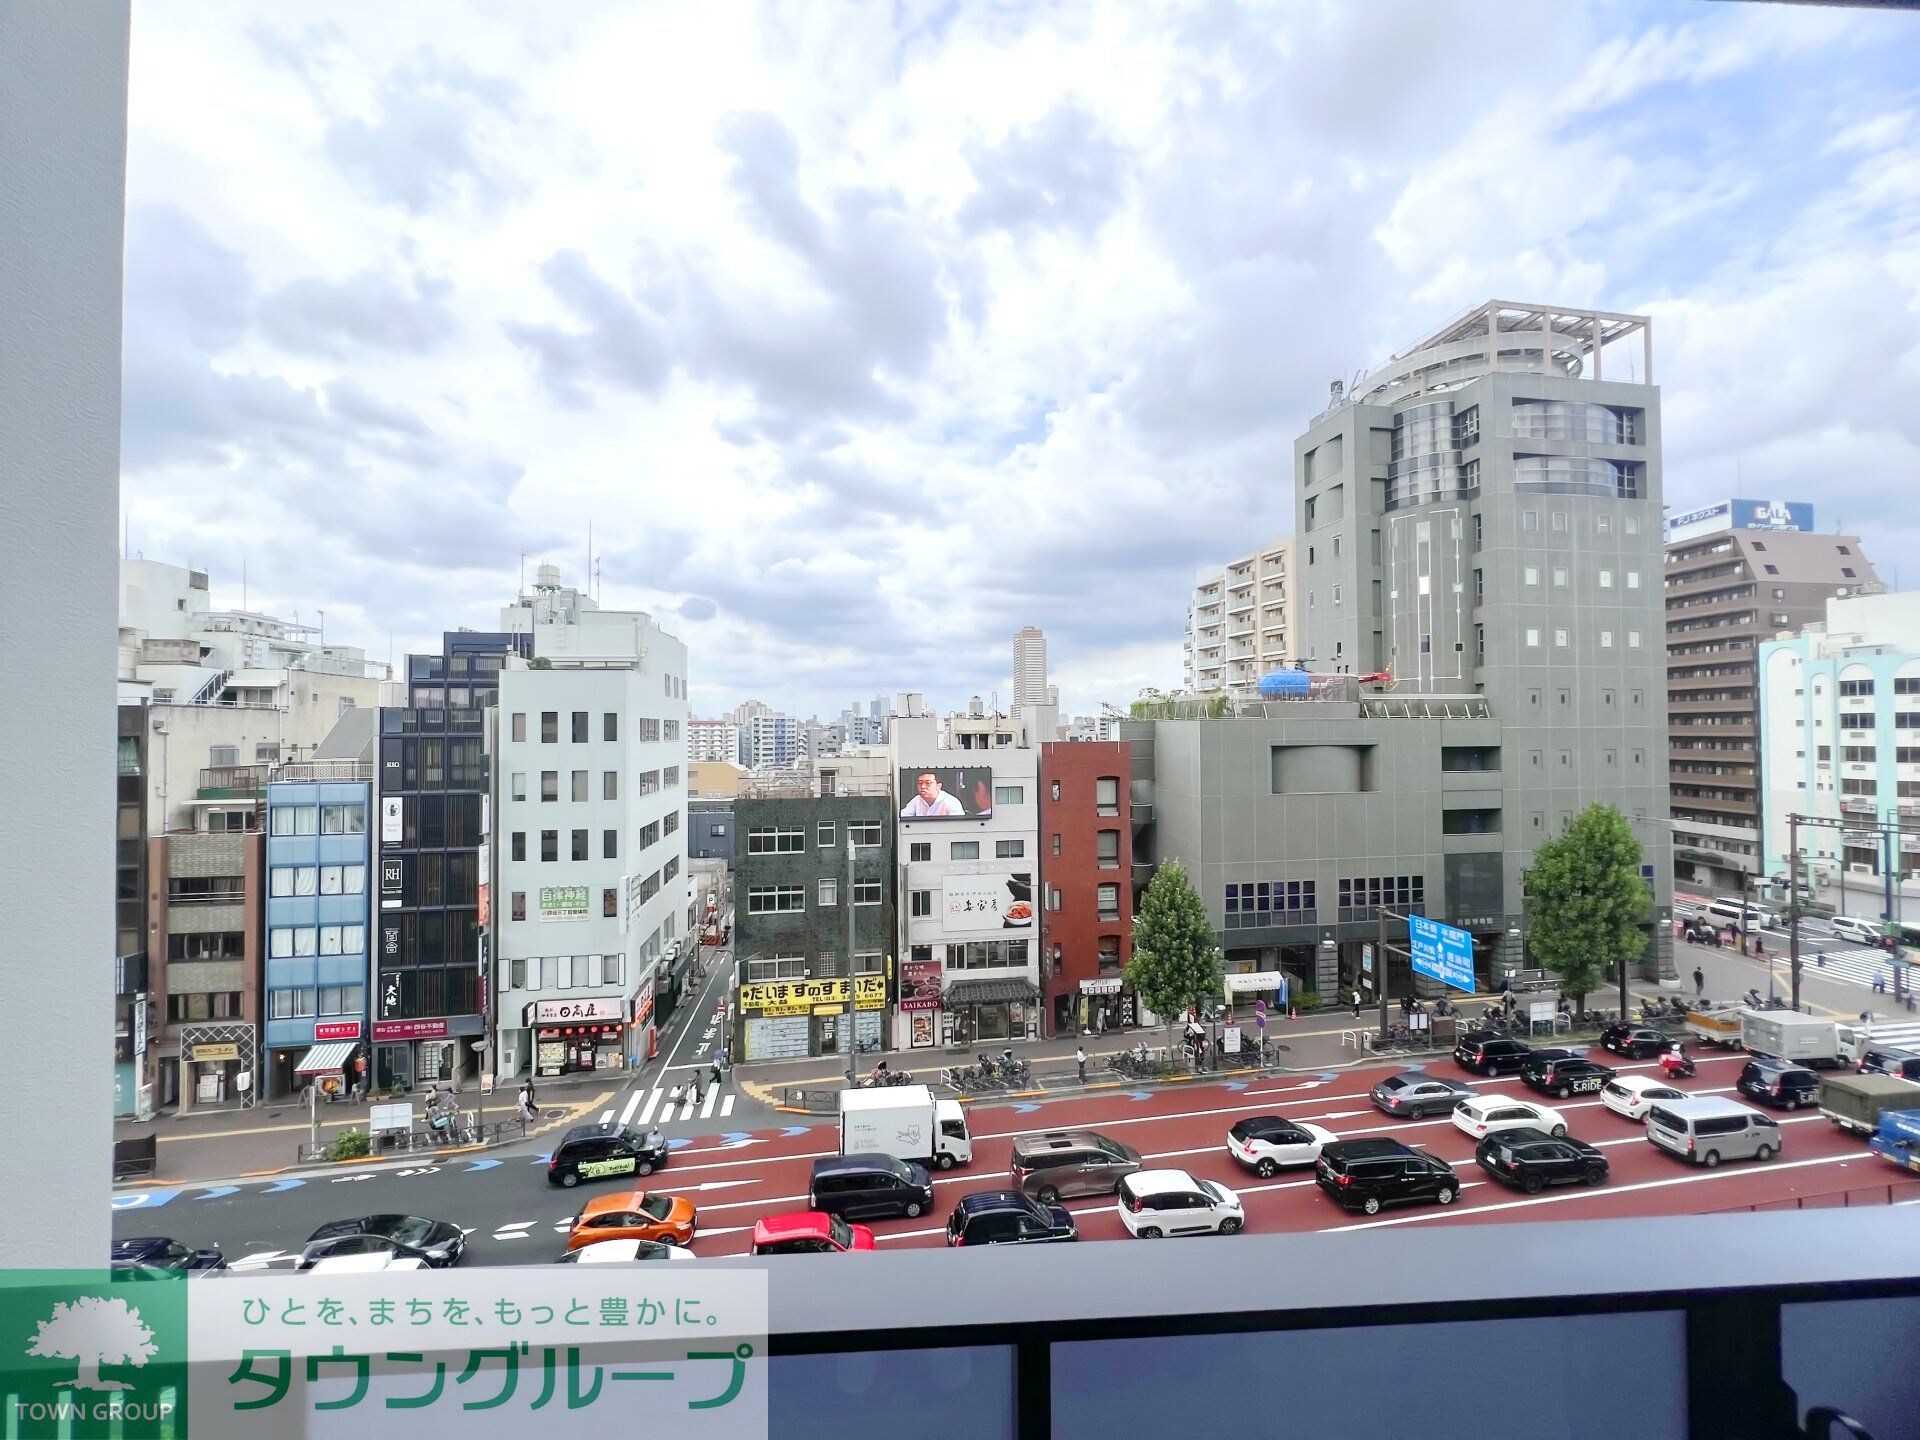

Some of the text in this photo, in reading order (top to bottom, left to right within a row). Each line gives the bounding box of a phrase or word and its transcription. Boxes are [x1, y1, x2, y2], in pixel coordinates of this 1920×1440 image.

[1755, 506, 1792, 520] GALA
[385, 868, 400, 881] RH
[542, 888, 587, 901] 自律神経
[385, 985, 398, 1006] 大地
[559, 1003, 598, 1018] 日高屋
[903, 1000, 938, 1009] SAIKABO
